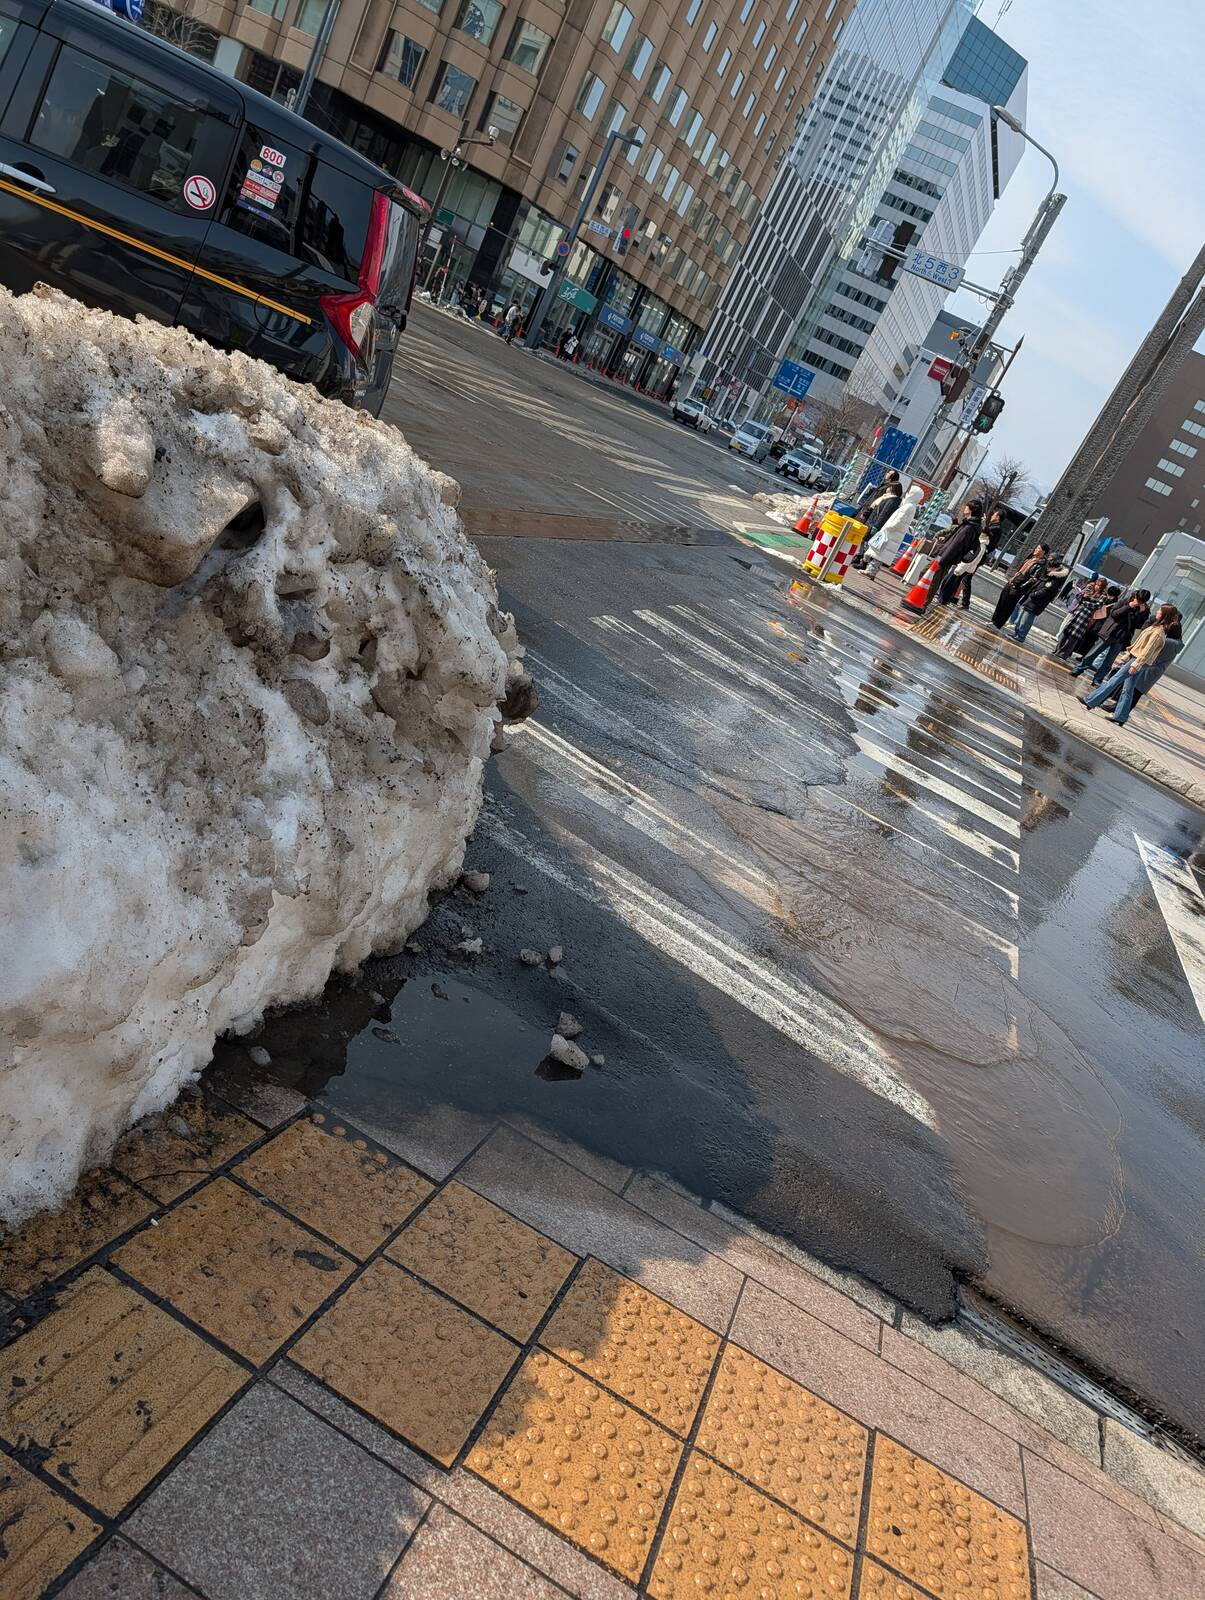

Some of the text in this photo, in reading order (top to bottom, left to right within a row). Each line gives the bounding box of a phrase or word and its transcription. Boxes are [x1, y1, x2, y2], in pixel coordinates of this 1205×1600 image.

[263, 148, 283, 165] 600
[911, 263, 926, 276] North
[932, 272, 947, 285] West
[912, 251, 960, 280] 北5西3
